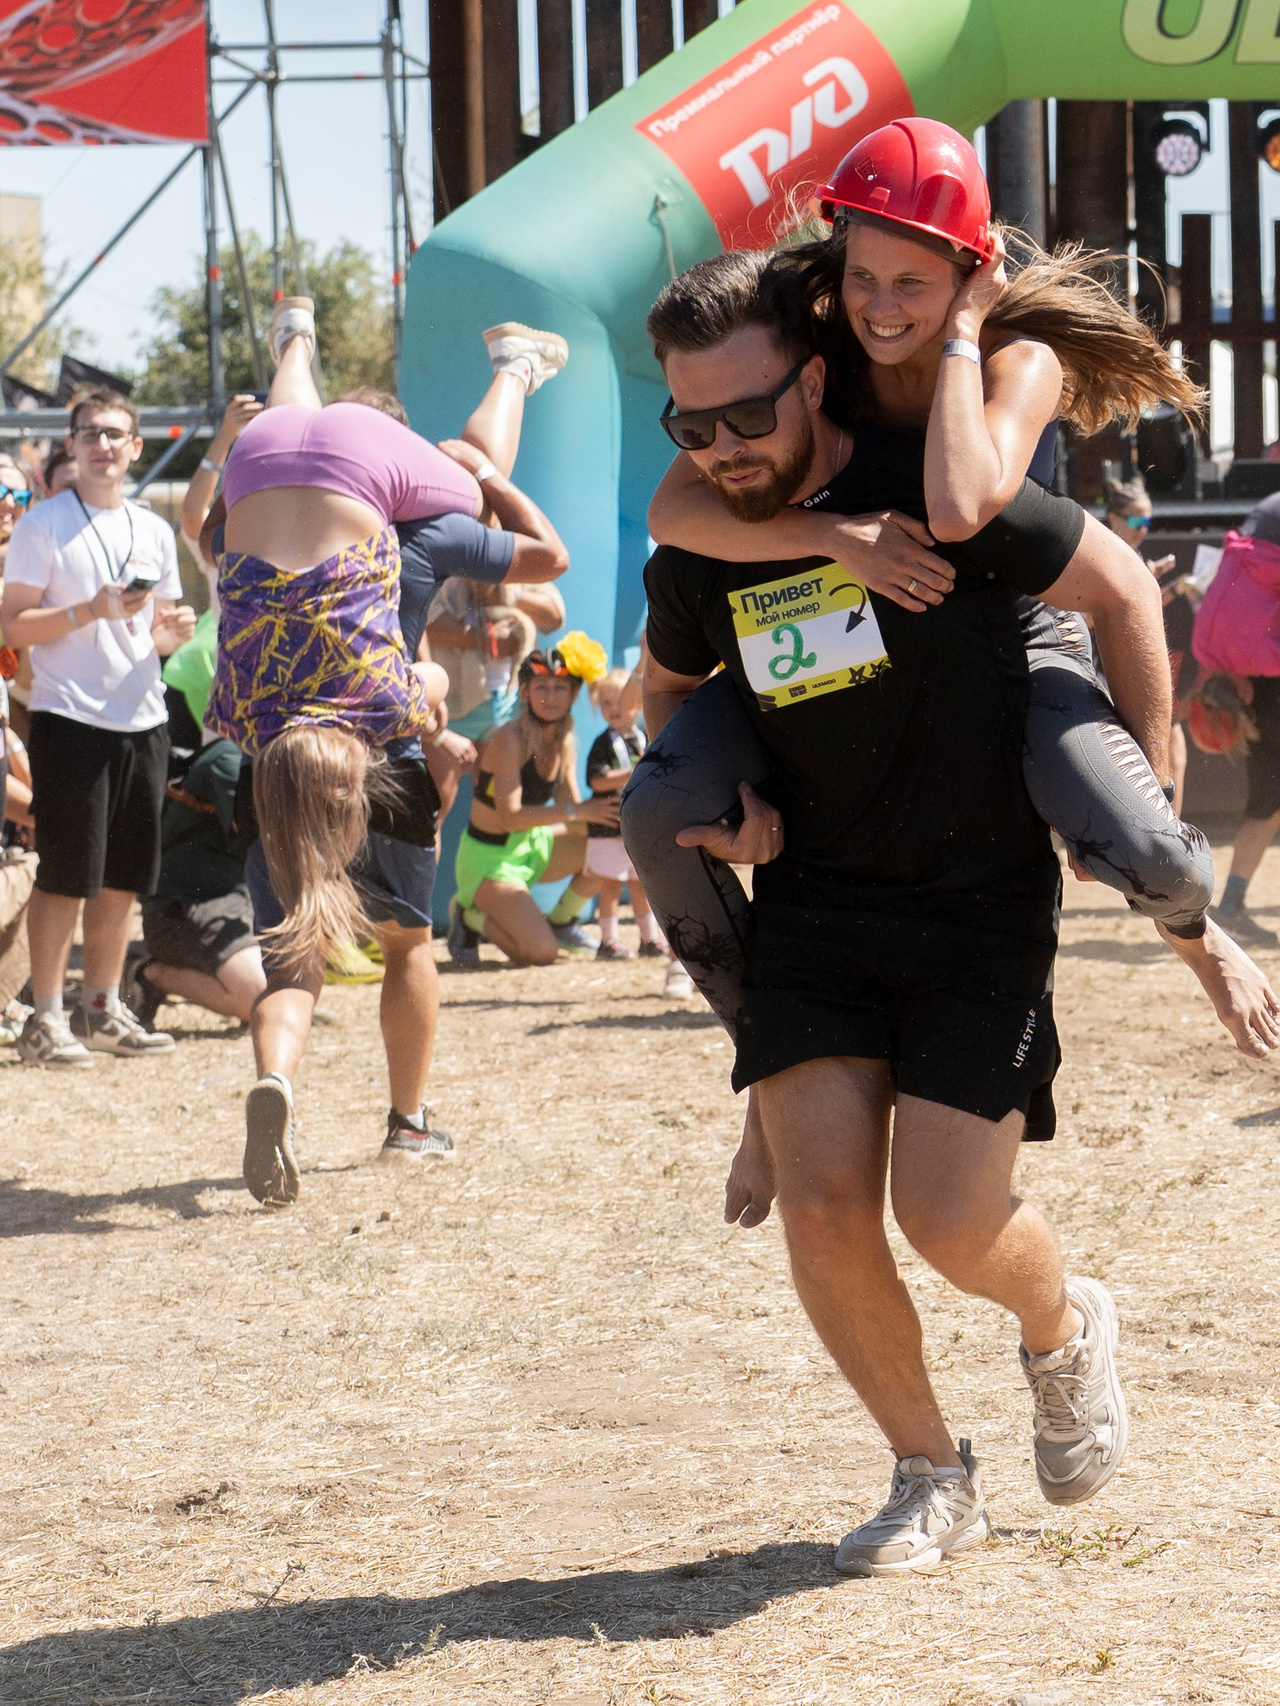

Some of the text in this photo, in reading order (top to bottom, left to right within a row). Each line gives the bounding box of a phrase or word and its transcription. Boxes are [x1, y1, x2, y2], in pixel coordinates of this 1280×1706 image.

[648, 3, 841, 138] Премиальный партнёр
[803, 488, 830, 508] Gain
[740, 576, 824, 615] Привет
[755, 600, 821, 628] мой номер
[768, 623, 817, 680] 2
[1012, 1008, 1037, 1068] LIFE STYLE
